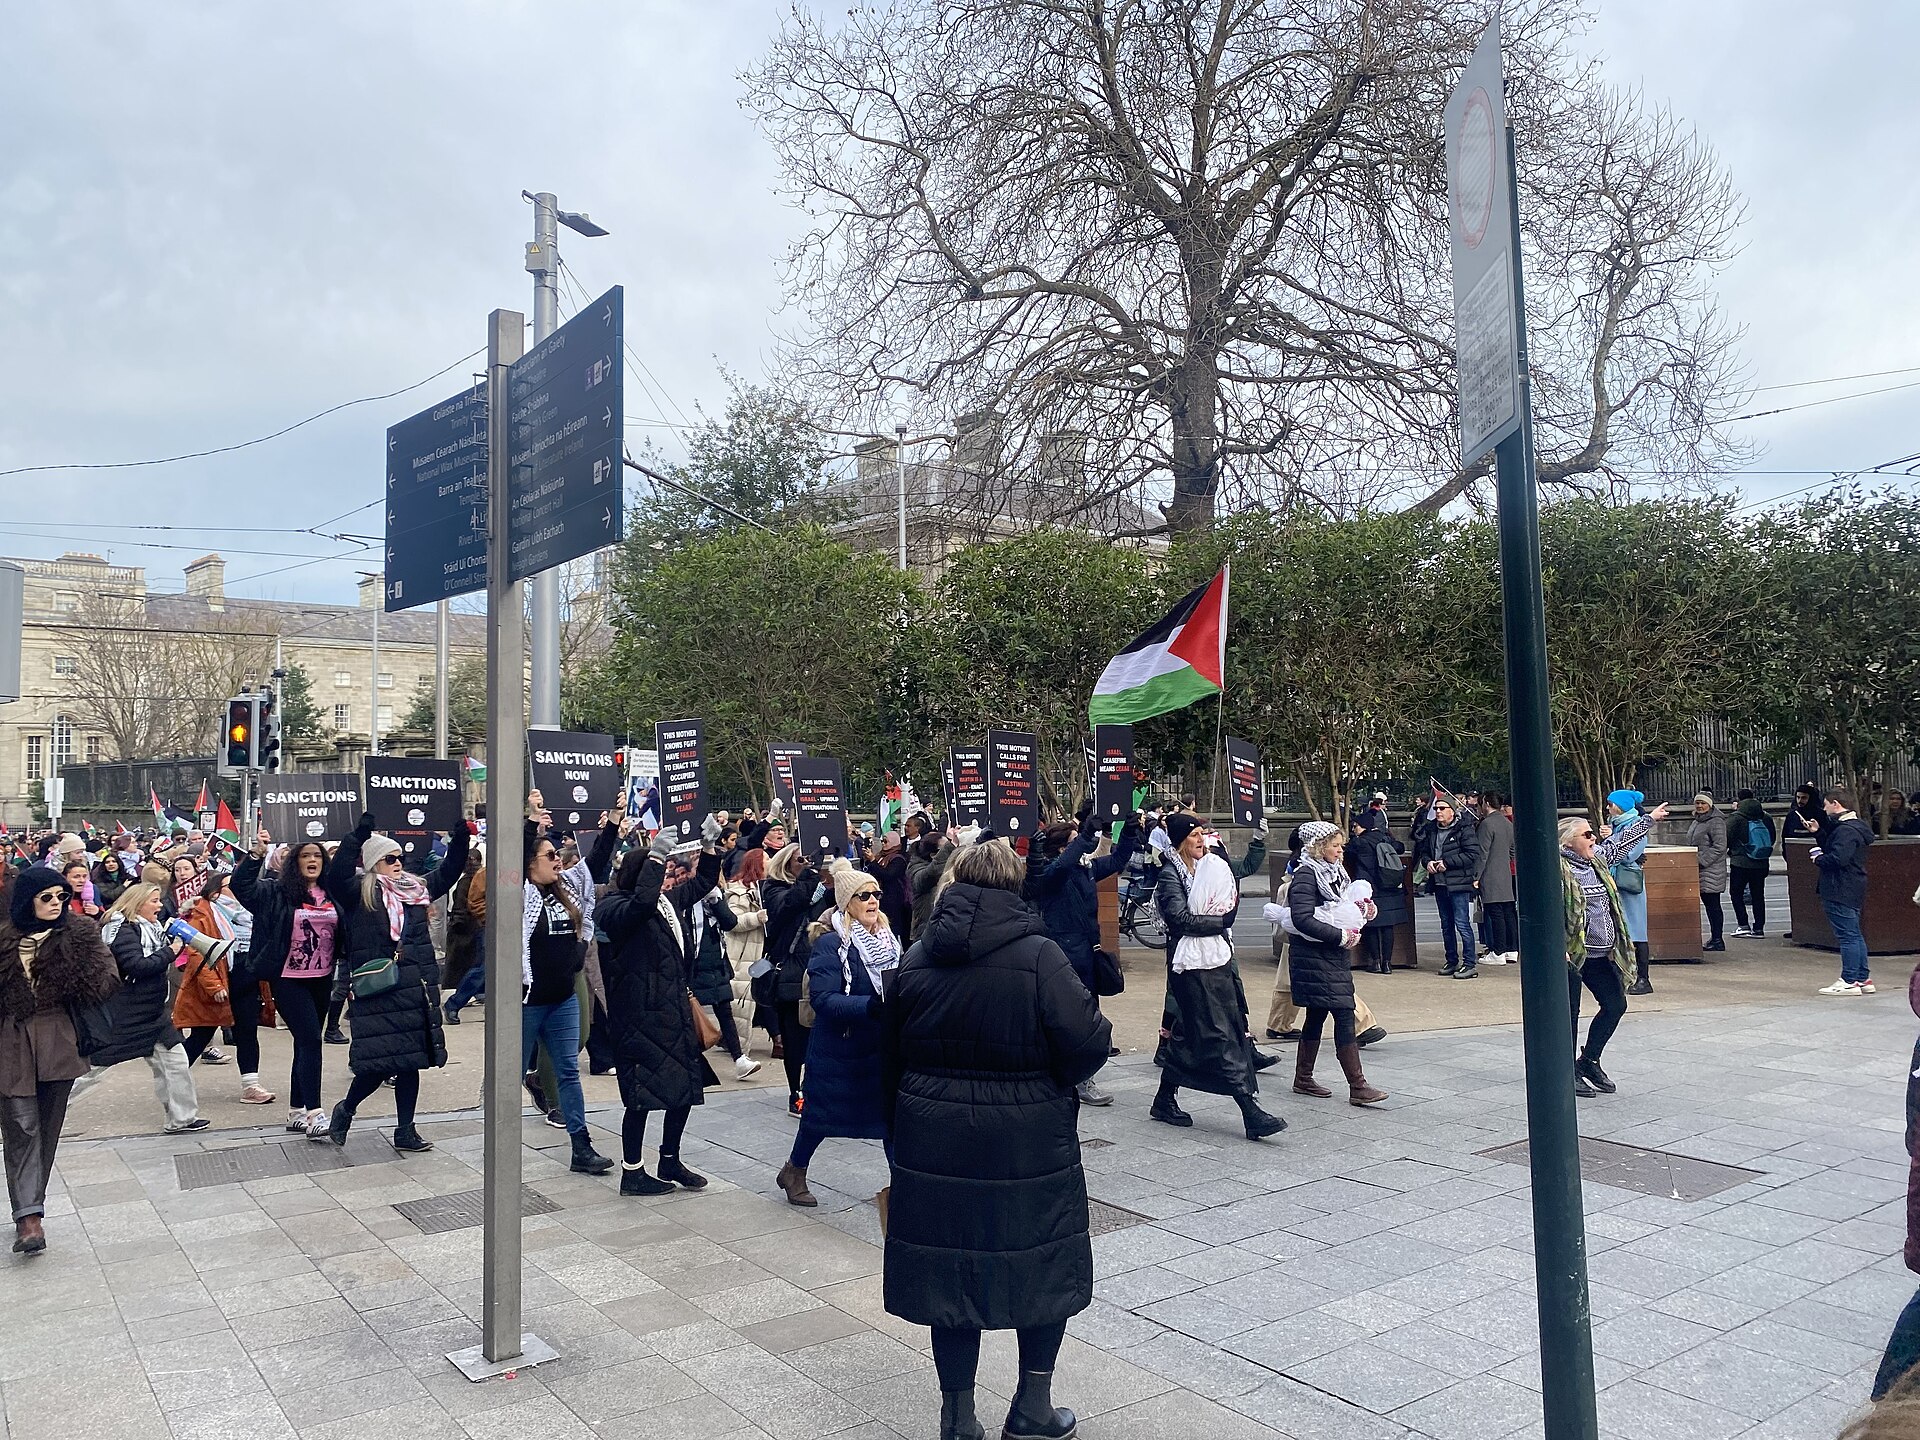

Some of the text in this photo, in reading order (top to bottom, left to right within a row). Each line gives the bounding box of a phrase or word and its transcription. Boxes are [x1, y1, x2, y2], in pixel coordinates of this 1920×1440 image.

[456, 400, 464, 411] na
[459, 430, 486, 448] Náisinta
[555, 430, 563, 442] na
[438, 481, 454, 497] Barra
[455, 480, 462, 491] an
[458, 534, 473, 547] River
[444, 559, 458, 574] Sráid
[444, 572, 488, 591] O'Connell Stre
[663, 729, 697, 740] THIS MOTHER
[664, 741, 683, 750] KNOWS
[996, 743, 1031, 753] THIS MOTHER
[535, 750, 613, 767] SANCTIONS
[665, 752, 680, 761] HAVE
[664, 764, 671, 772] TO
[672, 761, 689, 771] ENACT
[689, 760, 700, 768] THE
[1008, 762, 1031, 770] RELEASE
[564, 770, 590, 781] NOW
[669, 771, 696, 782] OCCUPIED
[370, 775, 457, 791] SANCTIONS
[667, 781, 699, 793] TERRITORIES
[997, 780, 1031, 788] PALESTINIAN
[265, 791, 358, 804] SANCTIONS
[400, 793, 429, 805] NOW
[670, 795, 682, 803] BILL
[682, 793, 692, 801] FOR
[298, 807, 328, 817] NOW
[175, 870, 208, 901] FREE
